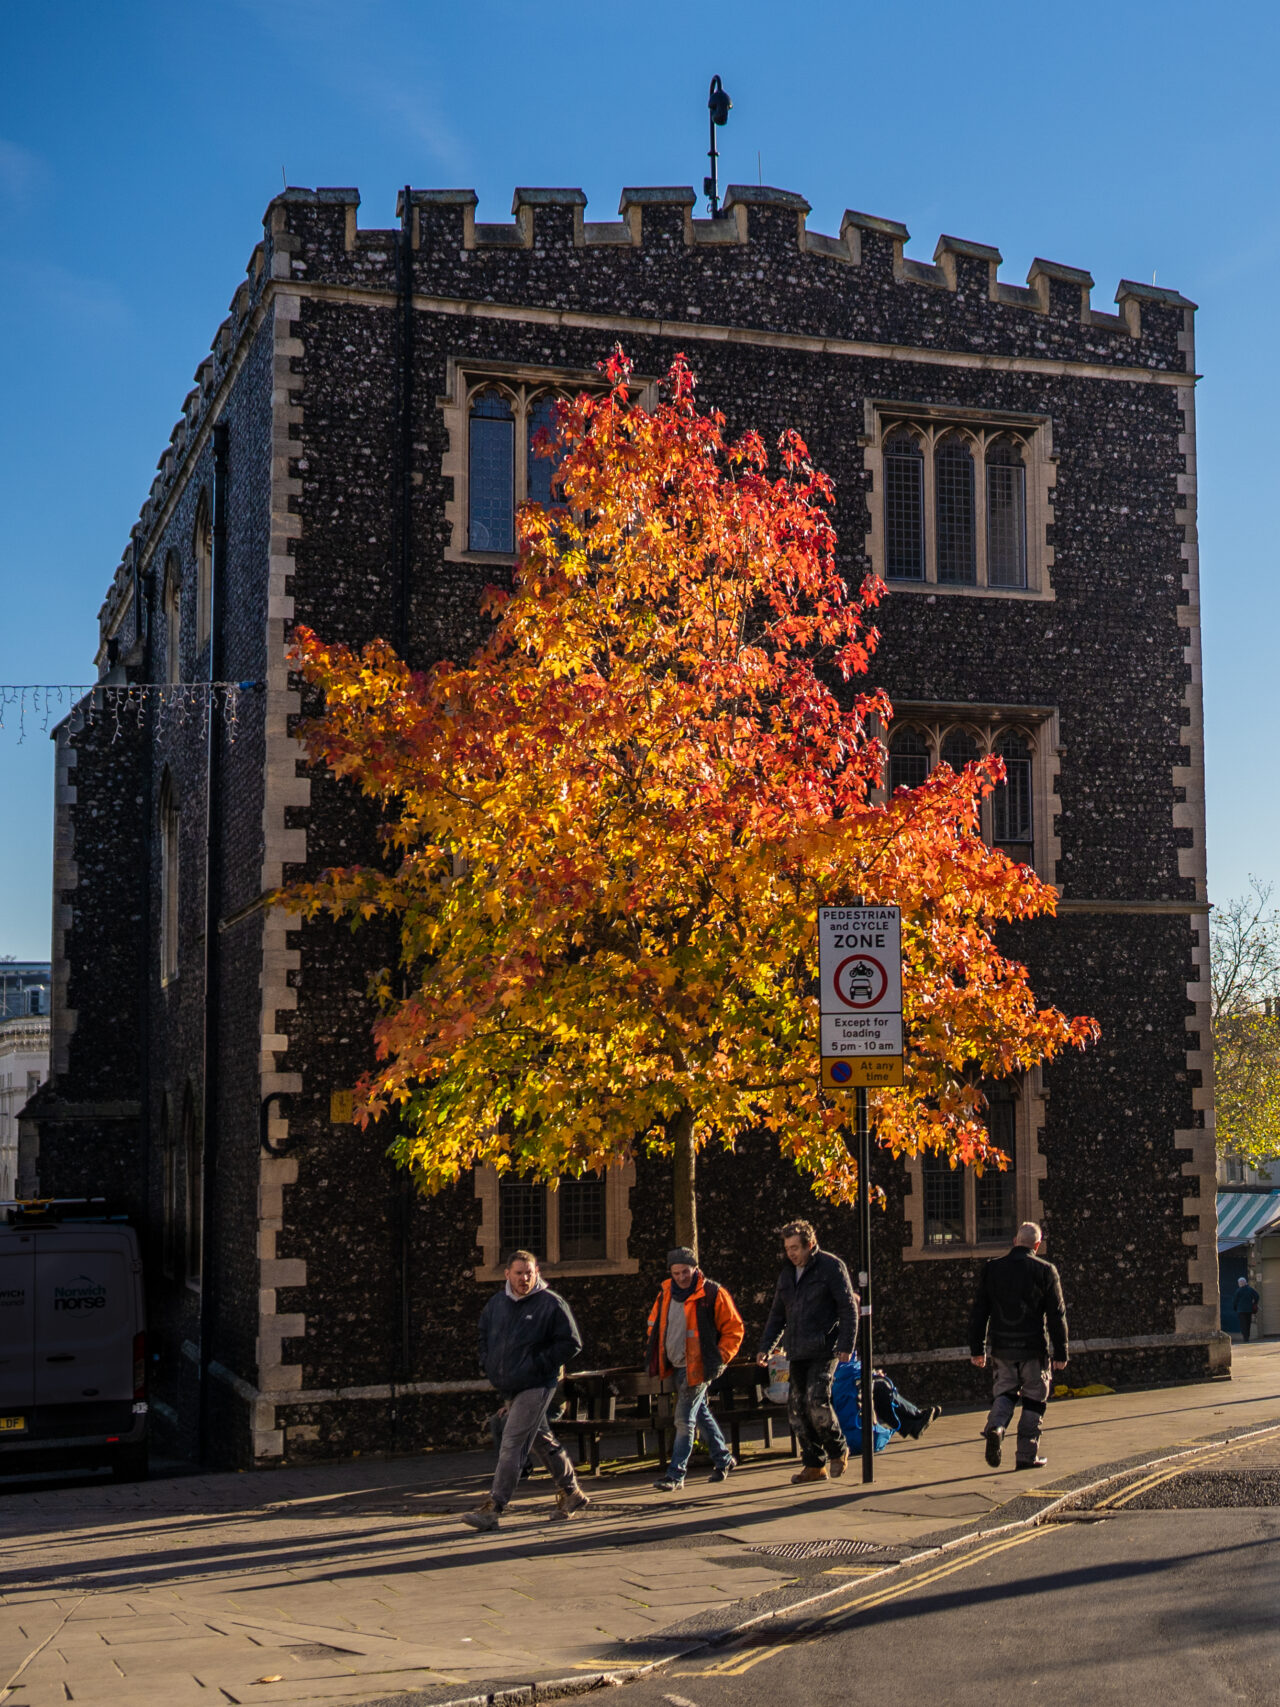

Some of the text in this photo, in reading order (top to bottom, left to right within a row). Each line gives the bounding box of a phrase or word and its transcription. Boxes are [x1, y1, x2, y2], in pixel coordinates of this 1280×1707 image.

[823, 910, 896, 920] PEDESTRIAN
[830, 921, 889, 931] and CYCLE
[834, 934, 886, 948] ZONE
[834, 1017, 889, 1028] Except for
[842, 1029, 881, 1039] loading
[860, 1061, 894, 1072] At any
[866, 1071, 889, 1081] time
[54, 1285, 106, 1298] Norwich
[54, 1296, 106, 1311] norse
